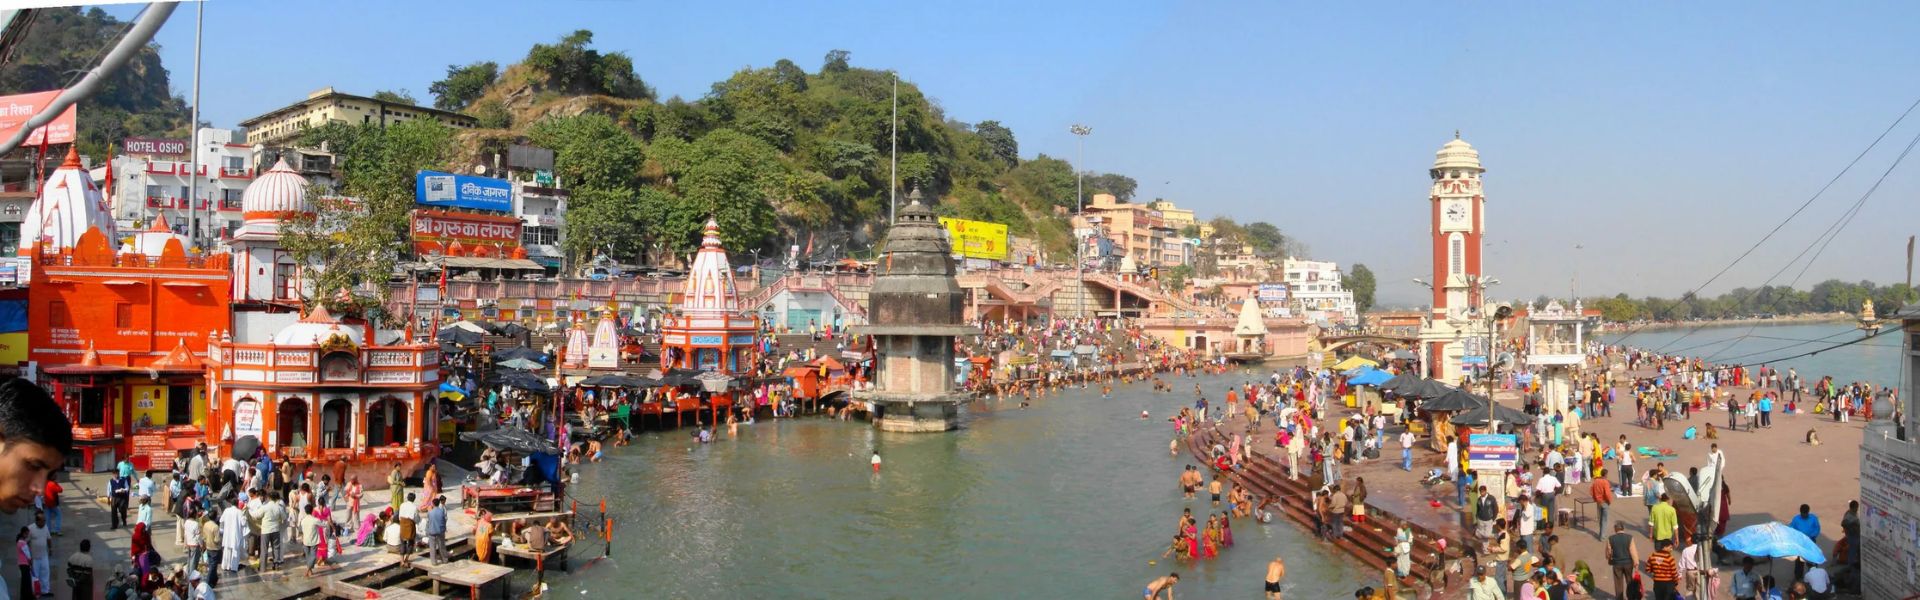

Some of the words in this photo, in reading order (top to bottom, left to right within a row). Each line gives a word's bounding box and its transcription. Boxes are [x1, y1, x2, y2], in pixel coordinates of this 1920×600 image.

[127, 141, 157, 153] HOTEL
[159, 142, 184, 154] OSHO
[461, 182, 482, 196] दैनिक
[482, 186, 509, 199] जागरण
[415, 217, 433, 234] श्री
[462, 222, 479, 237] का
[480, 223, 516, 239] लंगर
